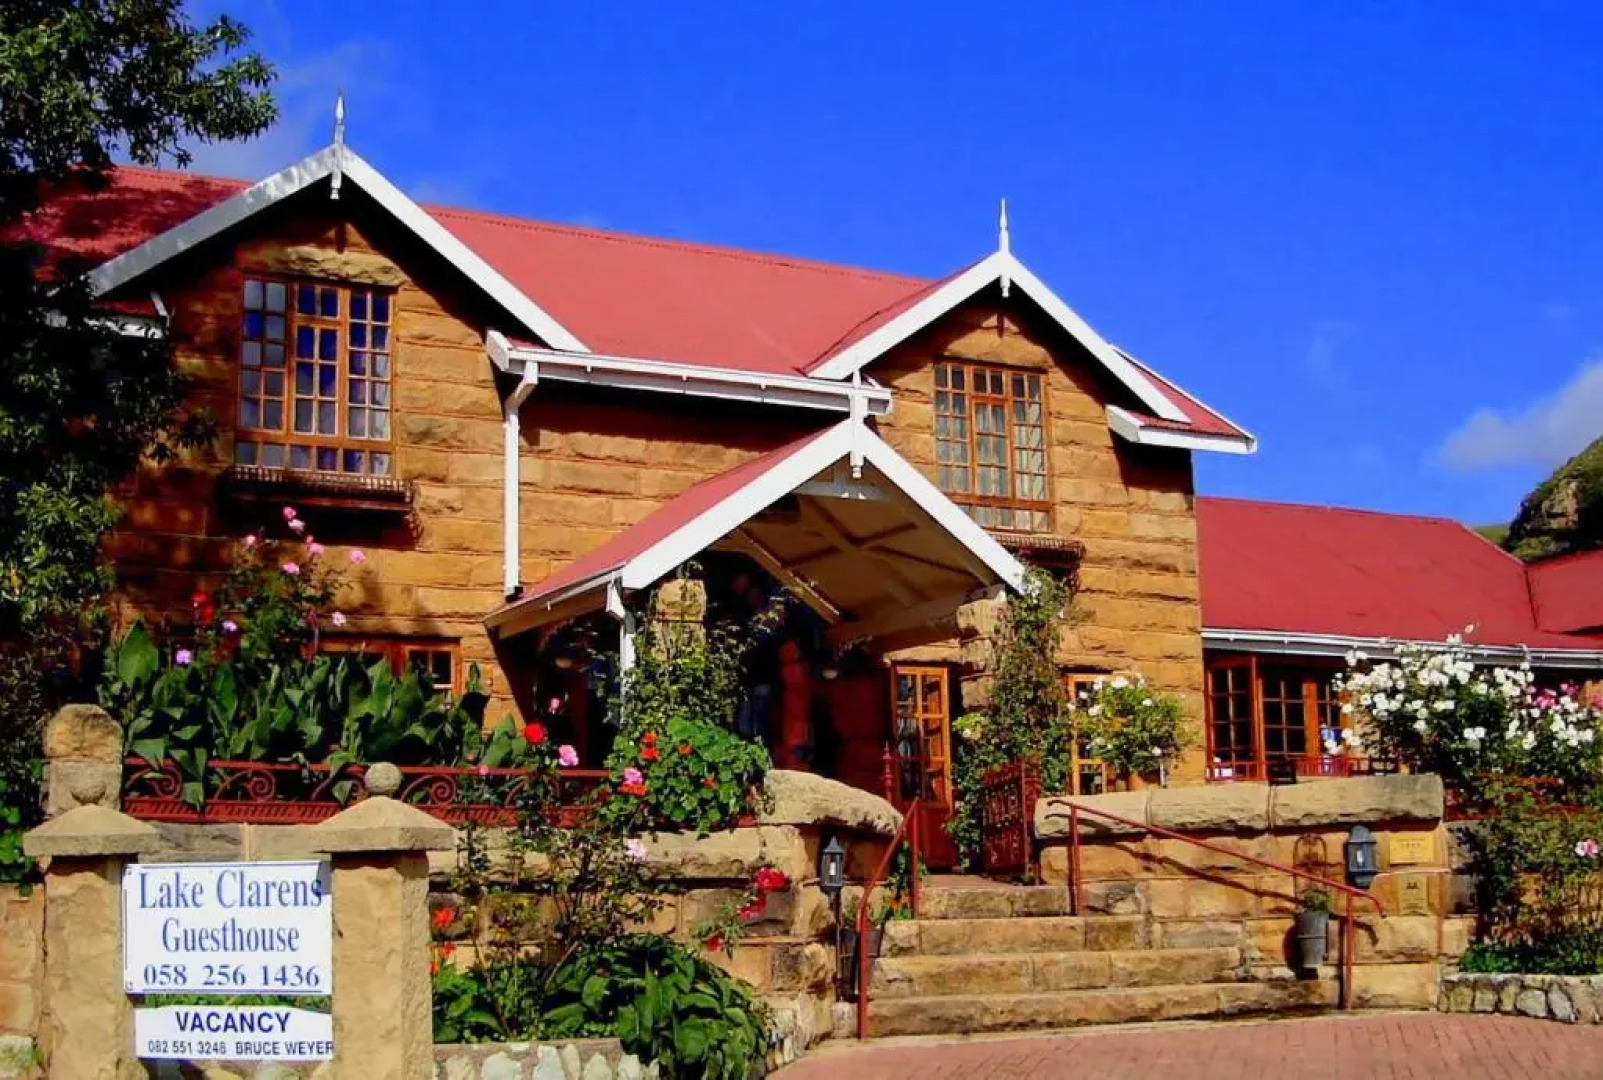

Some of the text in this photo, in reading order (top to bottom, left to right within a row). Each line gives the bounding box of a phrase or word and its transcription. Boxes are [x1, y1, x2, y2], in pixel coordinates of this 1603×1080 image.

[139, 869, 323, 909] Lake Clarens
[162, 917, 300, 953] Guesthouse
[143, 964, 320, 988] 058 256 1436
[175, 1011, 291, 1034] VACANCY
[172, 1041, 192, 1053] 551
[235, 1041, 280, 1056] BRUCE
